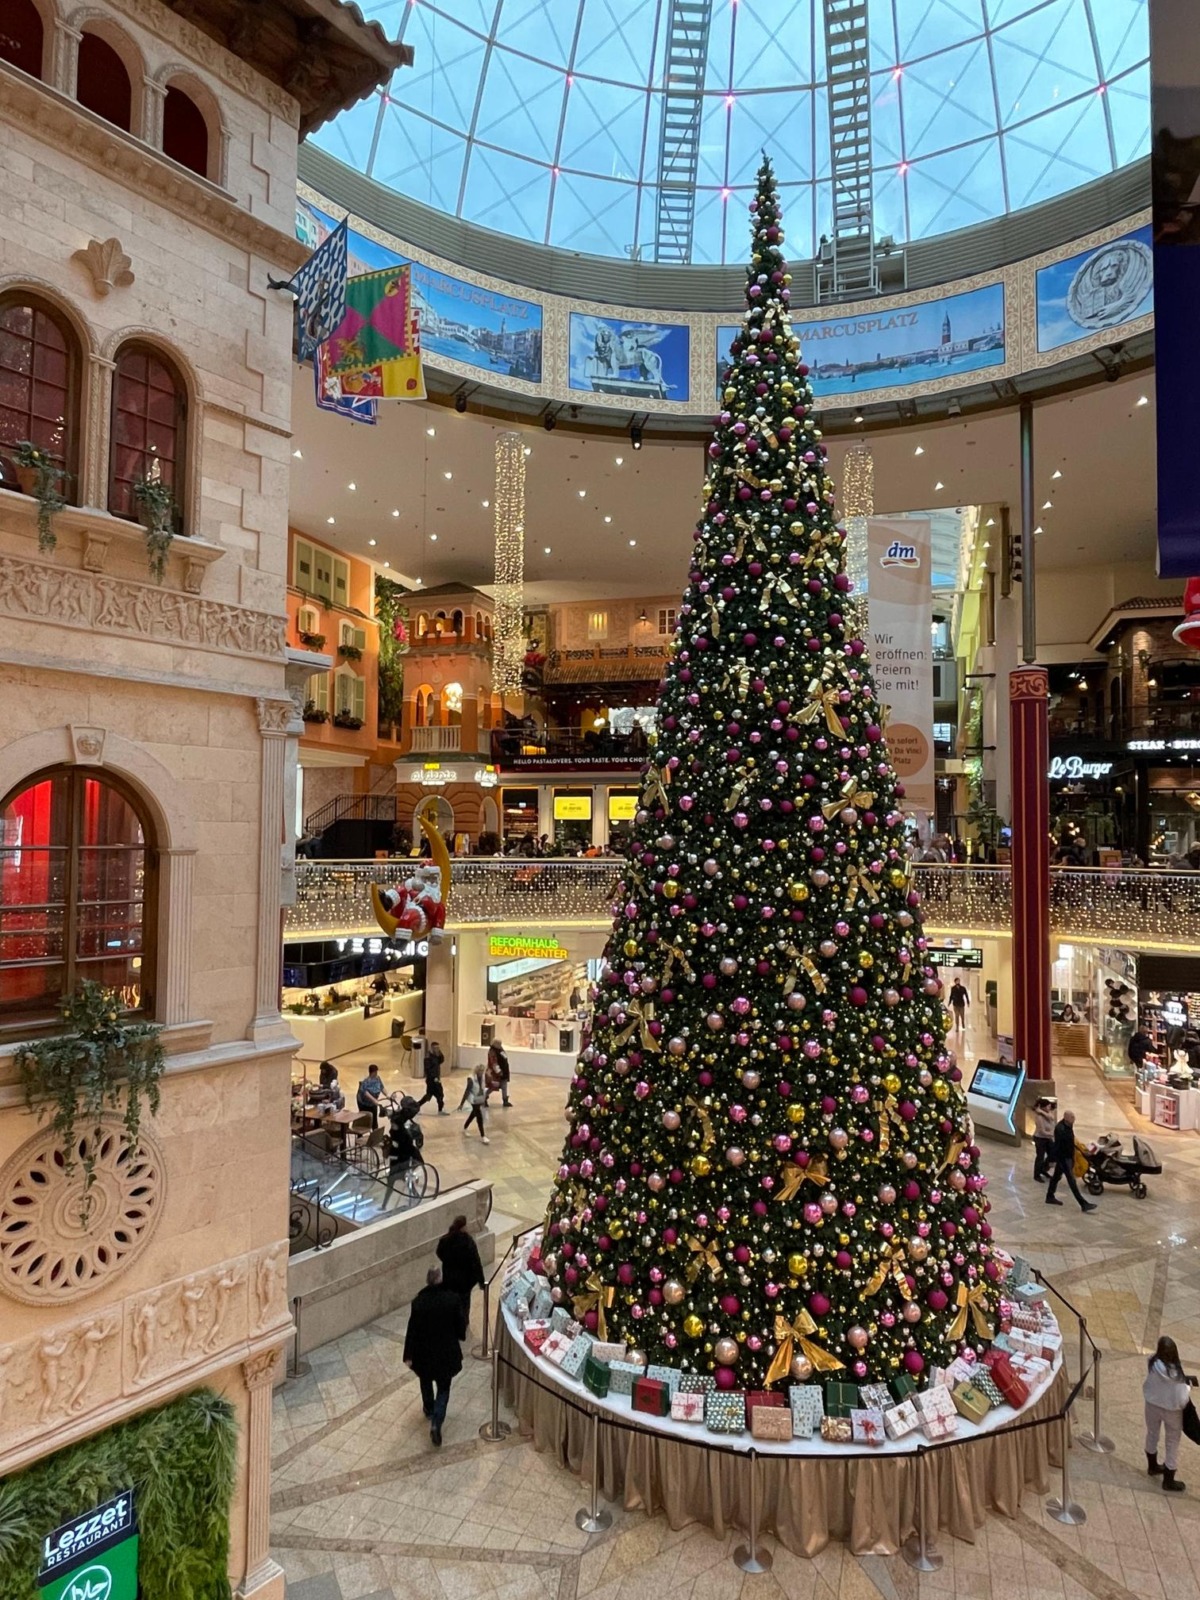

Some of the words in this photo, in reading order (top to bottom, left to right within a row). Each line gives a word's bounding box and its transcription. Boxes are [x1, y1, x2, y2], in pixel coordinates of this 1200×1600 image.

[888, 542, 915, 558] dm
[874, 633, 893, 644] Wir
[875, 648, 928, 660] eröffnen:
[875, 663, 911, 675] Feiern
[874, 679, 892, 690] Sie
[896, 679, 919, 691] mit!
[897, 736, 918, 744] sofort
[1128, 740, 1166, 750] STEAK
[906, 746, 922, 754] Vinci
[533, 757, 573, 765] PASTALOVERS.
[893, 756, 911, 764] Platz
[490, 936, 559, 949] REFORMHAUS
[490, 946, 568, 959] BEAUTYCENTER
[45, 1499, 127, 1558] Lezzet
[47, 1517, 124, 1567] RESTAURANT
